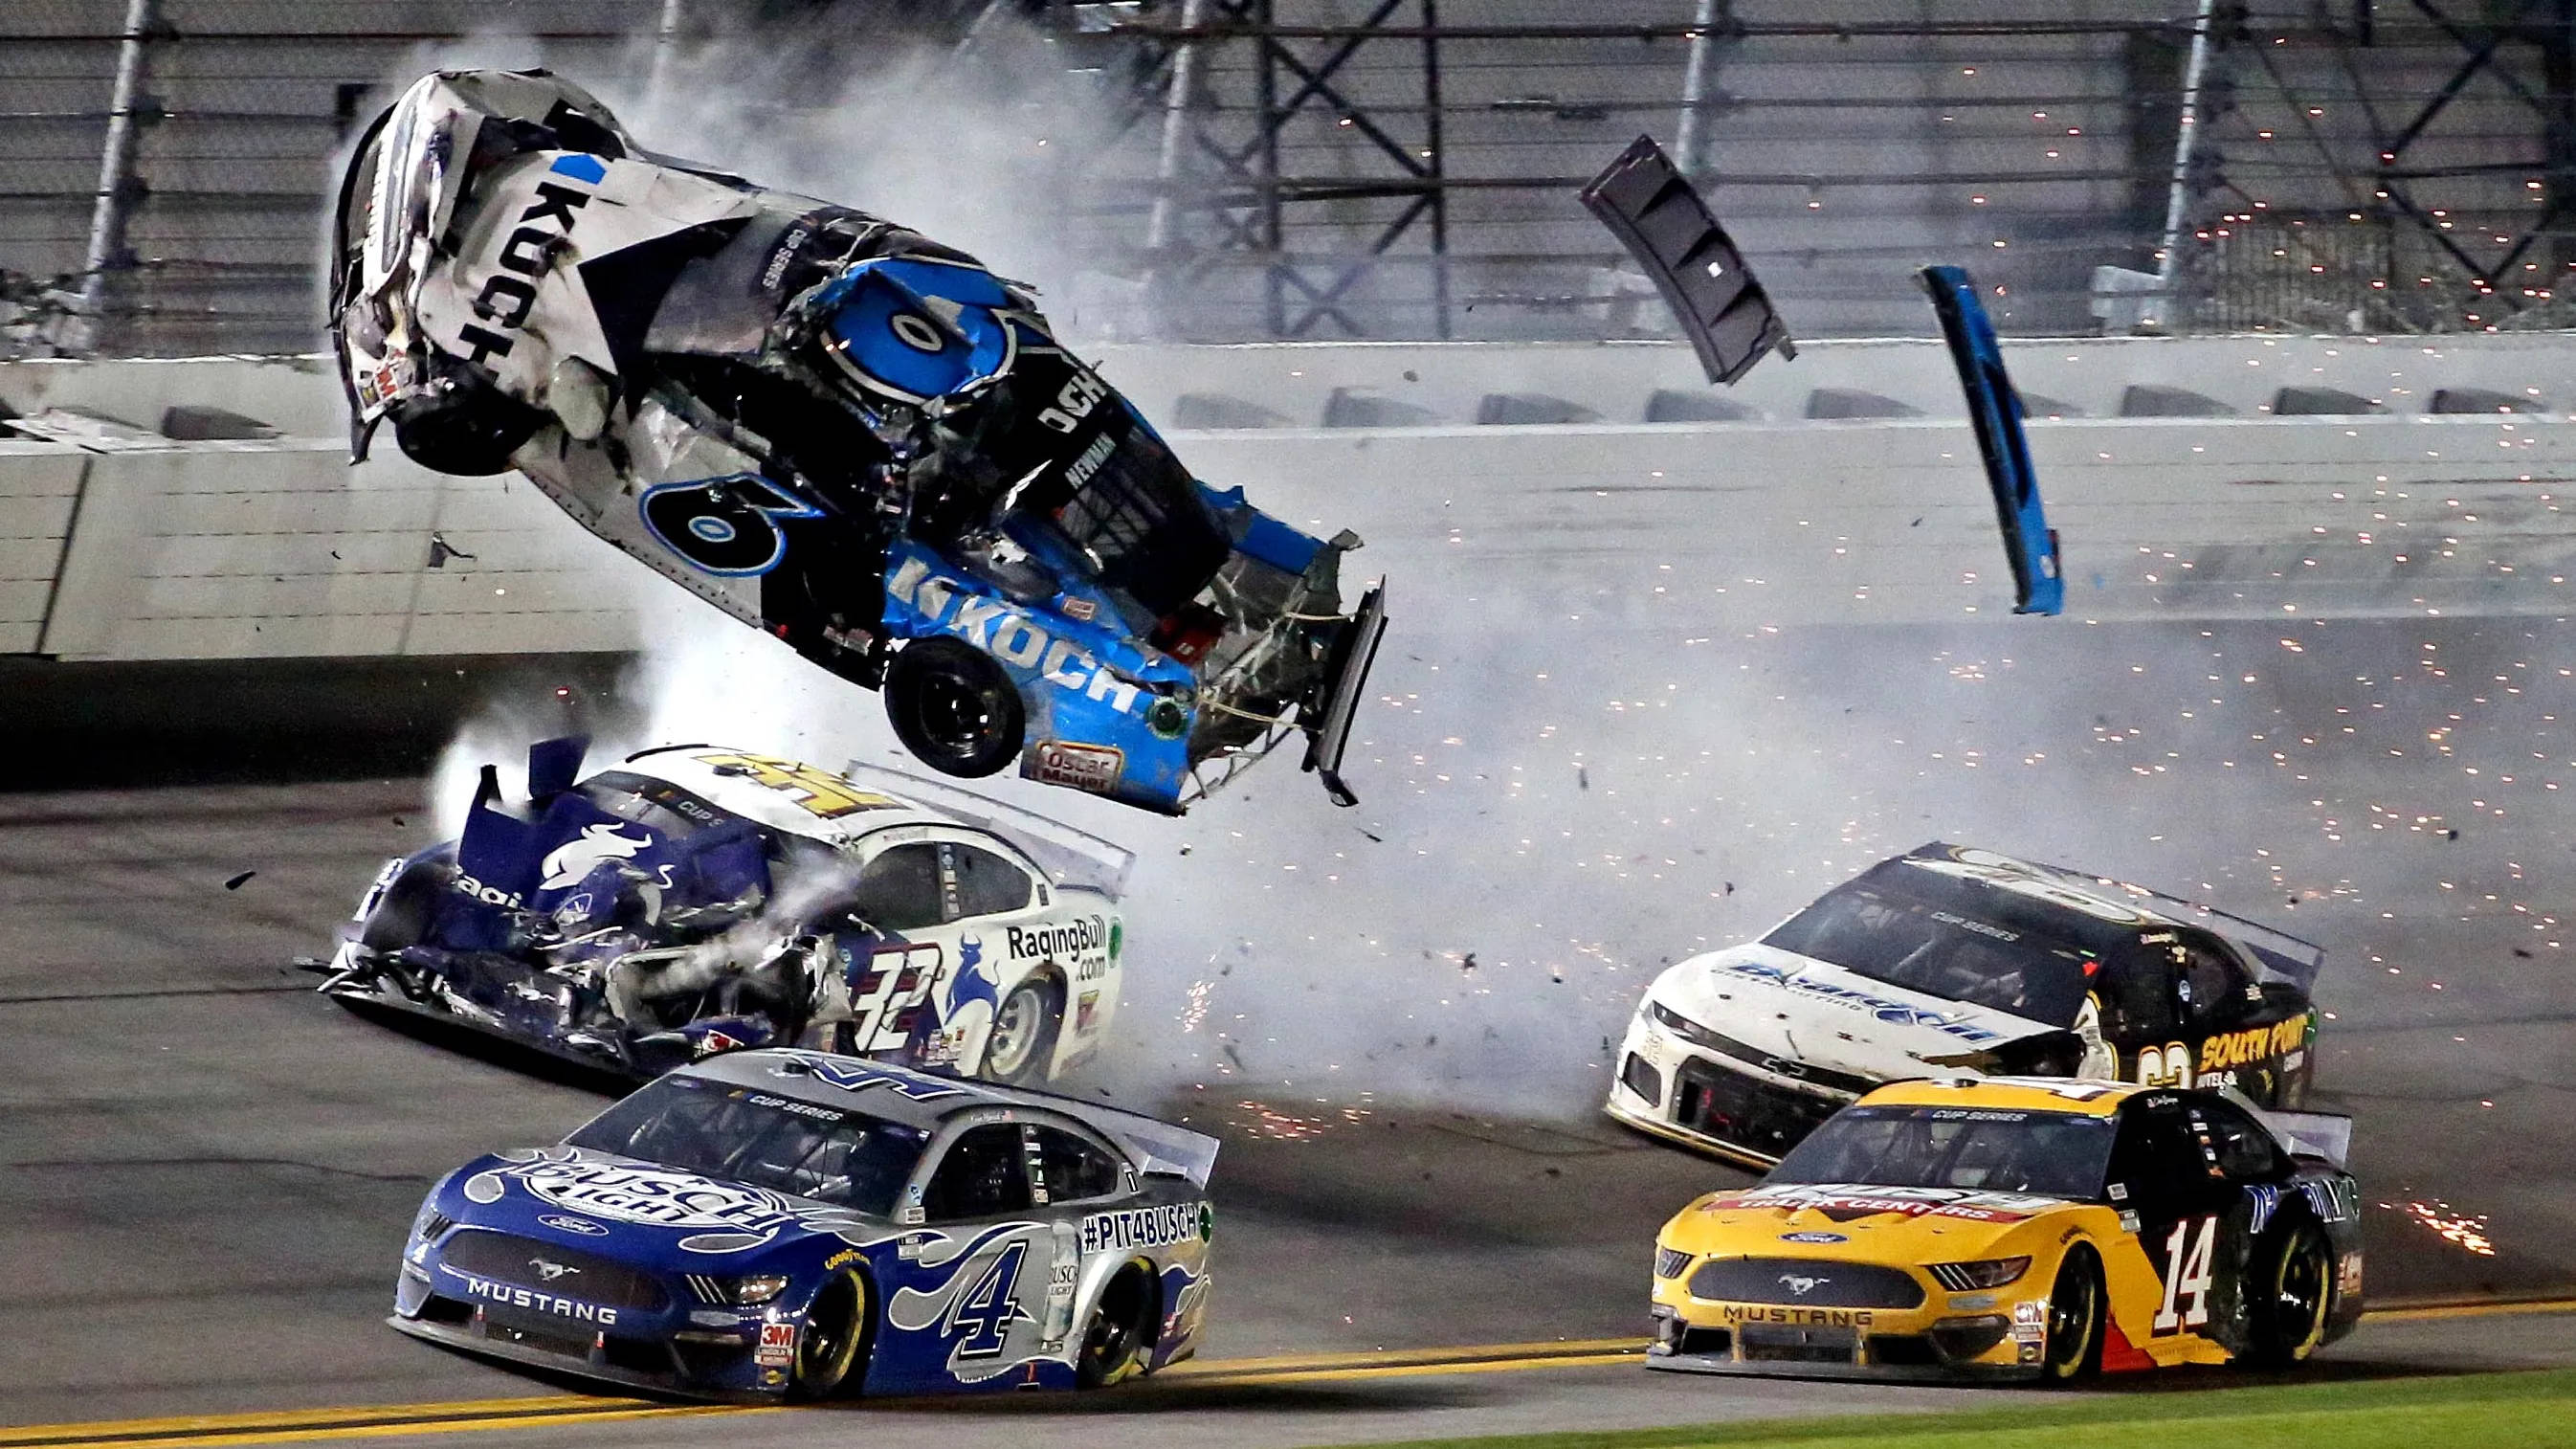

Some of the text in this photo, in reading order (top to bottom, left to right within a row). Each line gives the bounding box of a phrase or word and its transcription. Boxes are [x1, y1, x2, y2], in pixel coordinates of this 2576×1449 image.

[458, 180, 591, 386] KOCH
[945, 594, 1142, 714] KOCH
[1048, 752, 1110, 774] Oscar
[677, 800, 711, 822] CUP
[1006, 914, 1106, 964] RagingBull
[1075, 955, 1105, 982] .com
[2198, 1028, 2270, 1073] SOUTH
[749, 1095, 844, 1122] CUP SERIES
[1931, 1109, 2029, 1123] CUP SERIES
[507, 1159, 792, 1235] BUSCH
[1083, 1203, 1199, 1253] #PIT4BUSCH
[2152, 1215, 2218, 1334] 14
[467, 1278, 618, 1326] MUSTANG
[953, 1238, 1030, 1361] 4
[1723, 1304, 1874, 1327] MUSTANG
[763, 1325, 794, 1347] 3M
